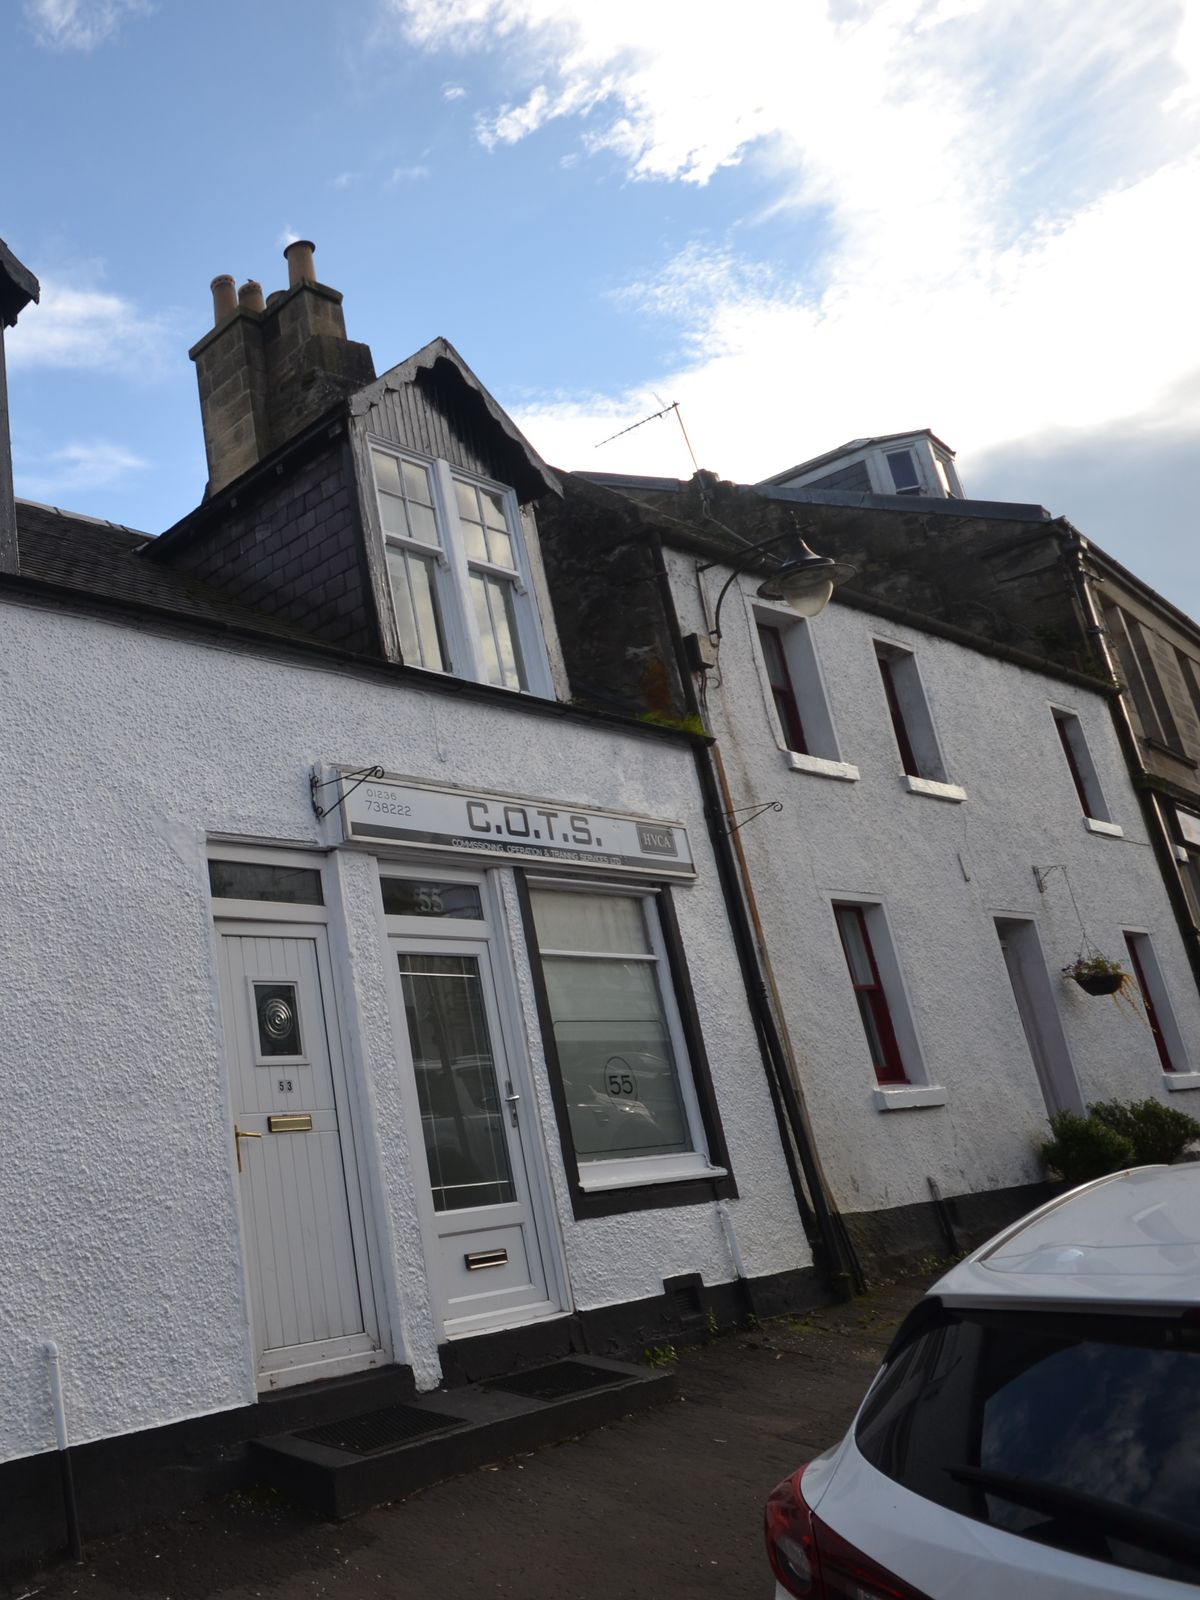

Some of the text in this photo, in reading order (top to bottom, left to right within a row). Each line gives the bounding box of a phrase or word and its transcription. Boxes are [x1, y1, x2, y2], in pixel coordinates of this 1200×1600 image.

[366, 789, 397, 800] 01236
[365, 800, 412, 817] 738222
[466, 801, 602, 847] C.O.T.S.
[506, 845, 543, 857] OPERATION
[544, 848, 551, 857] &
[551, 850, 578, 861] TRAINING
[580, 855, 608, 864] SERVICES
[609, 1075, 633, 1095] 55
